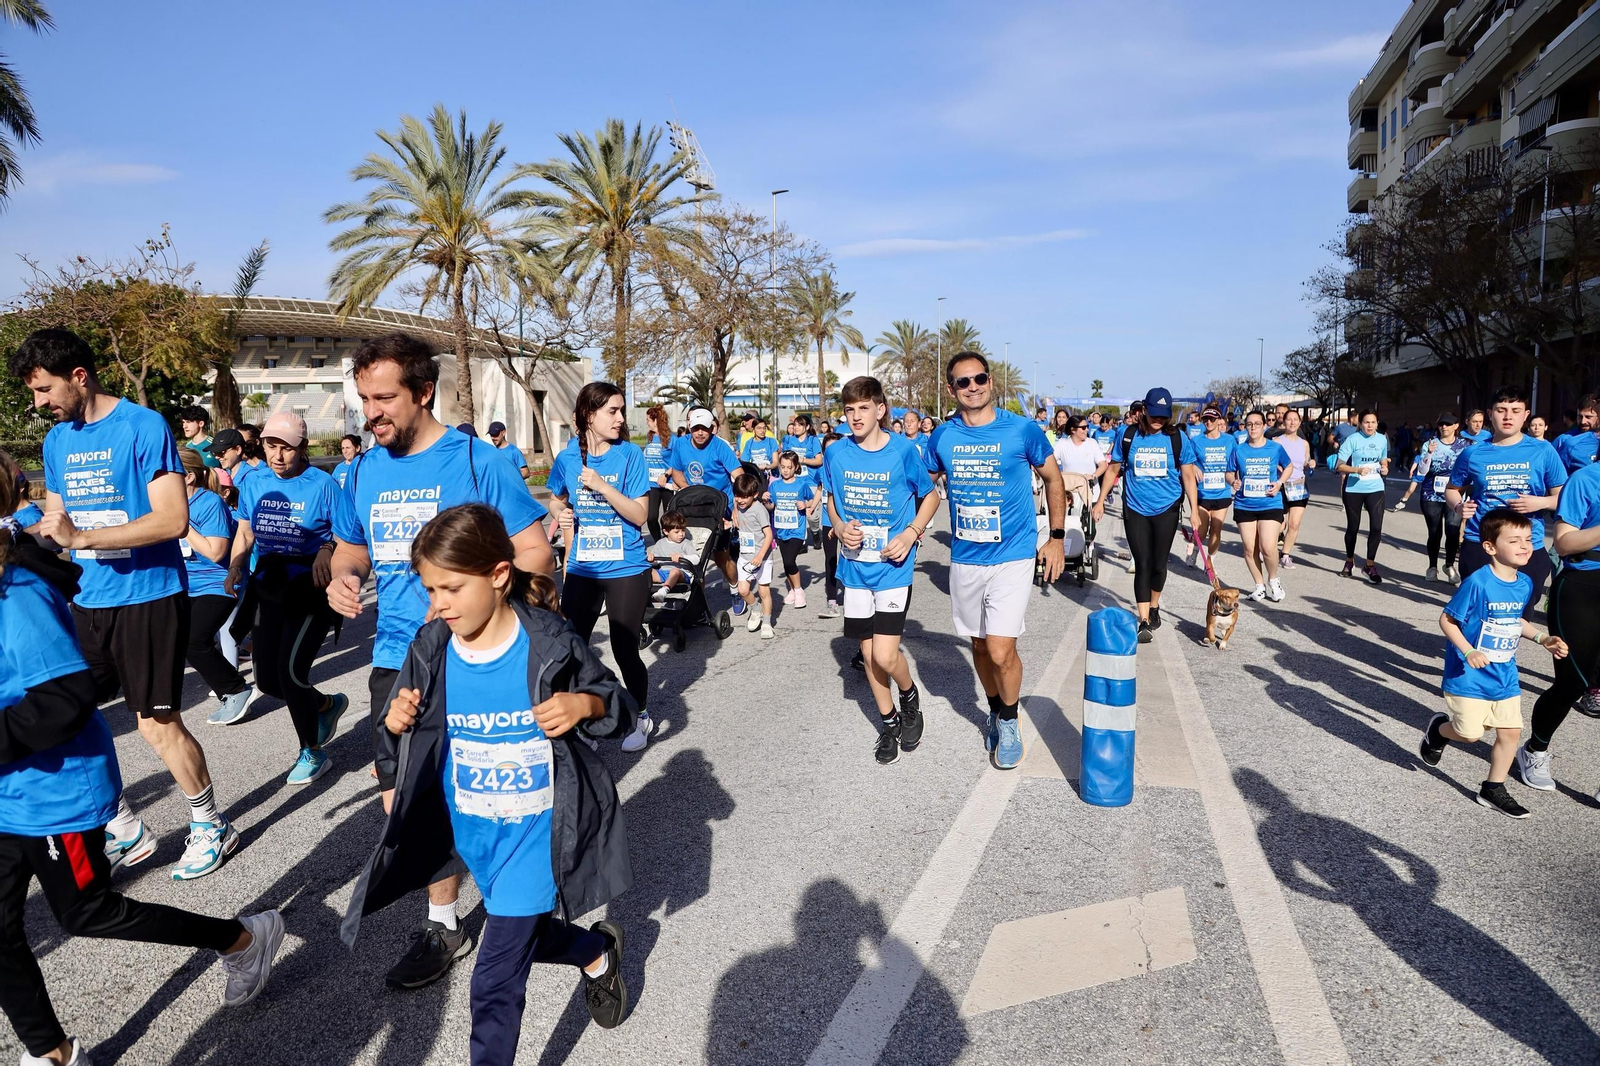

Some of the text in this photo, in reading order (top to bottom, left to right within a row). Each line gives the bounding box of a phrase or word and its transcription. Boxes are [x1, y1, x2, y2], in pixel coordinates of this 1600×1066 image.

[953, 443, 1000, 454] mayoral
[1140, 460, 1160, 468] 2516
[1486, 462, 1530, 471] mayoral
[844, 470, 890, 482] mayoral
[378, 485, 441, 503] mayoral
[261, 500, 306, 510] mayoral
[961, 518, 990, 529] 1123
[383, 522, 422, 539] 2422
[586, 538, 613, 548] 2320
[1488, 602, 1524, 612] mayor
[447, 710, 537, 734] mayora
[466, 749, 489, 757] Carrera
[467, 755, 494, 764] Solidaria
[470, 768, 533, 791] 2423
